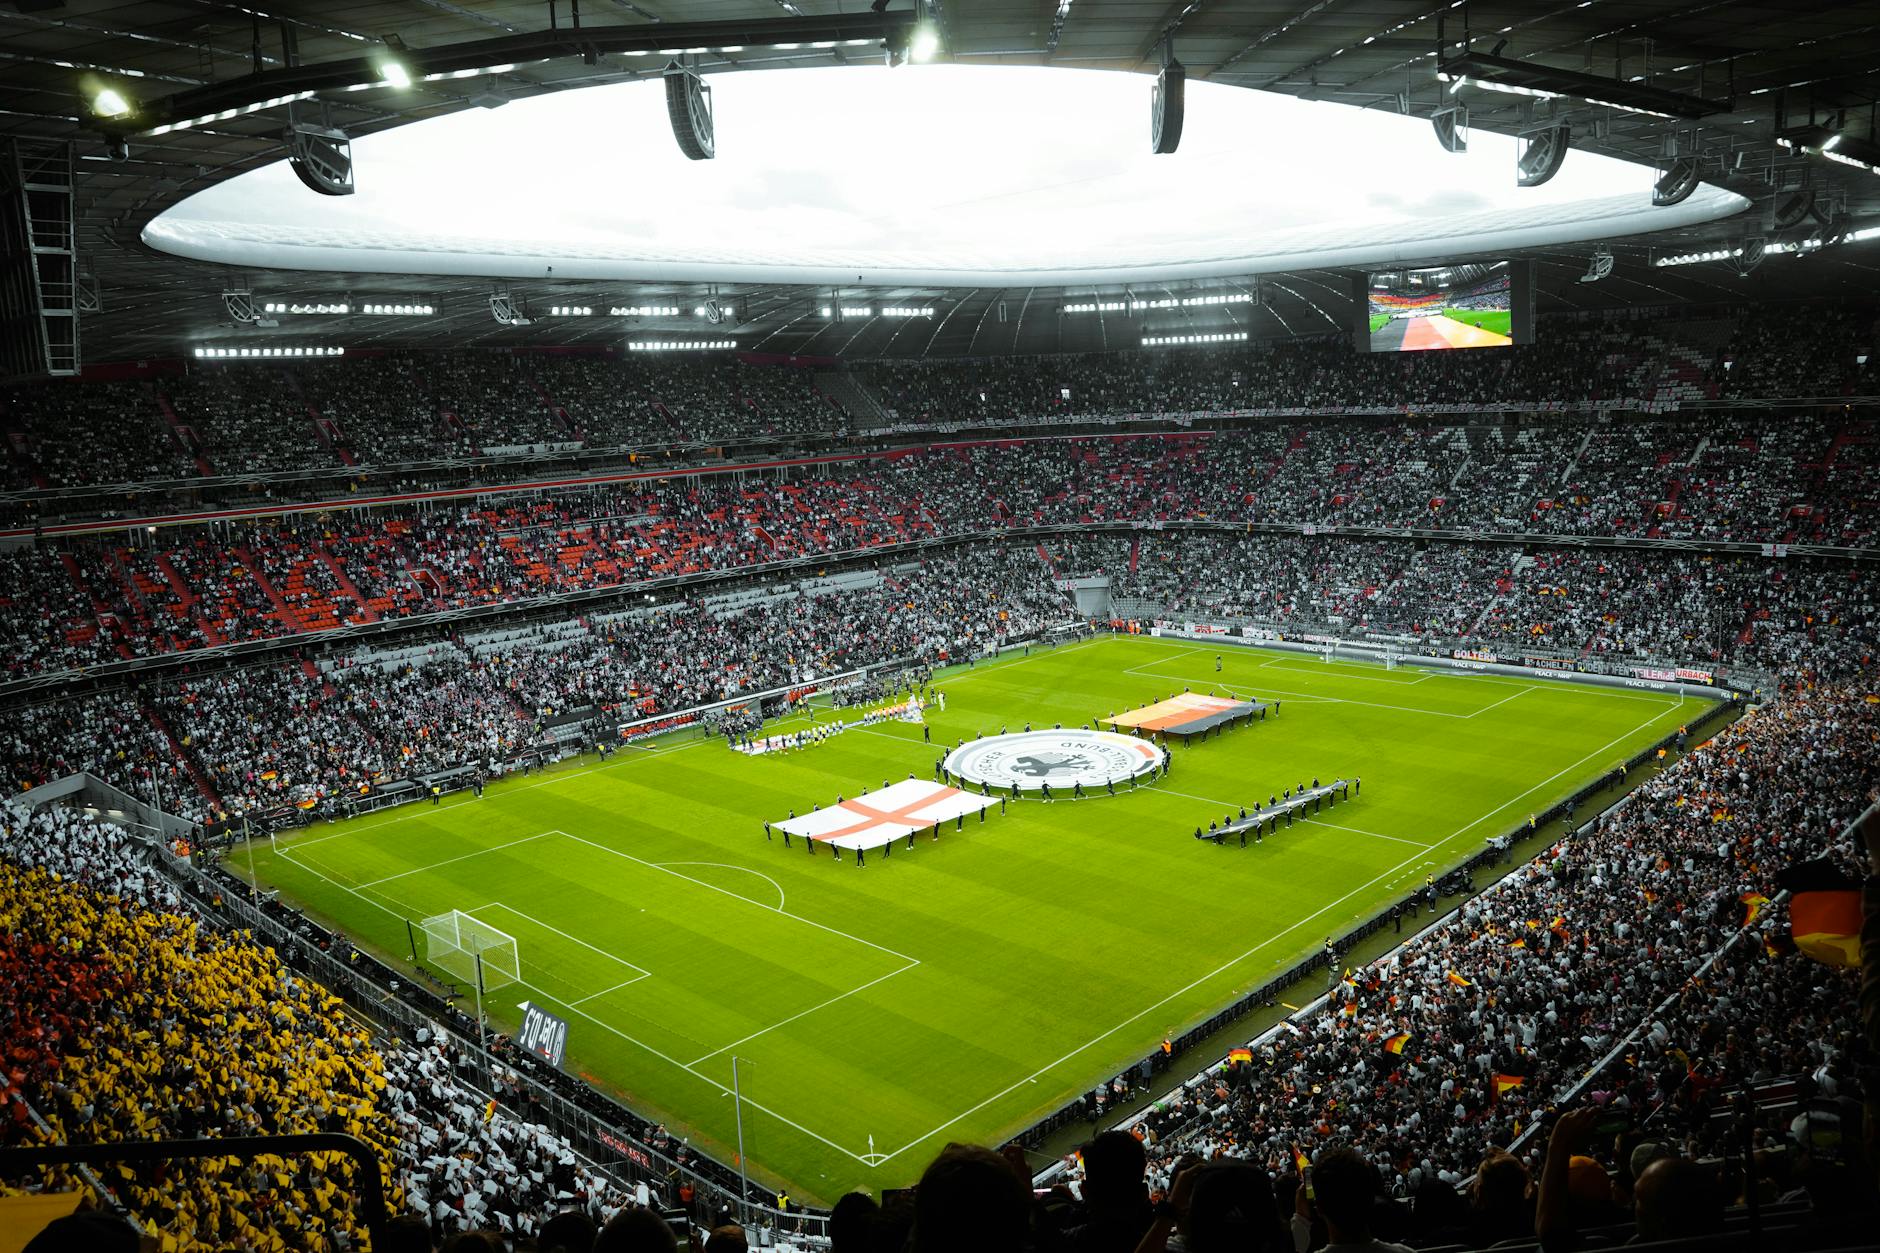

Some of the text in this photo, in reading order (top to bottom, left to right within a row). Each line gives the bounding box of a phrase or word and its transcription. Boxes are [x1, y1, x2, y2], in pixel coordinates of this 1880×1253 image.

[1453, 650, 1497, 663] GOLTERN
[1451, 660, 1468, 668] PEACE
[1534, 670, 1553, 678] PEACE
[1676, 668, 1711, 681] URBACH
[1625, 679, 1645, 687] PEACE
